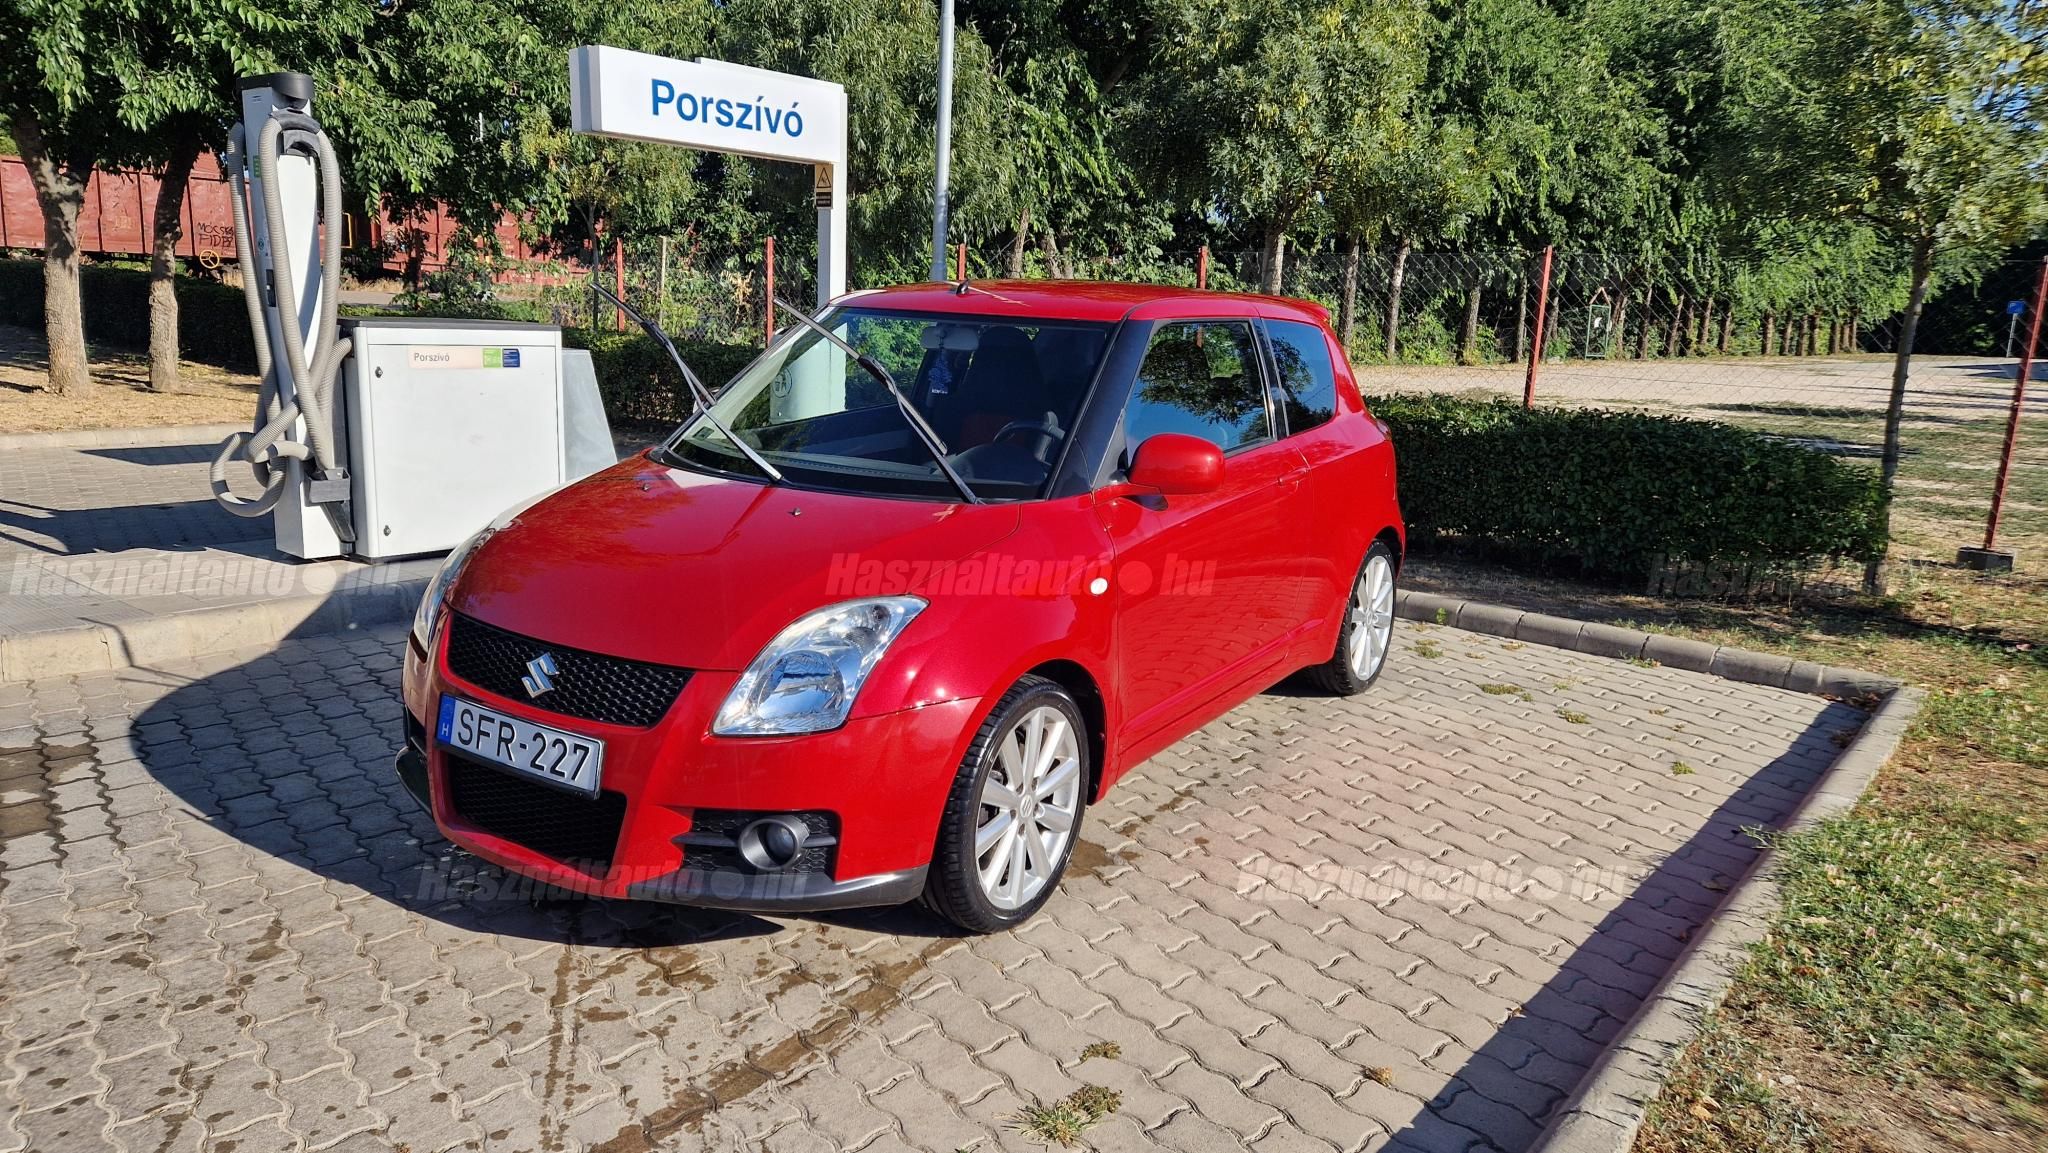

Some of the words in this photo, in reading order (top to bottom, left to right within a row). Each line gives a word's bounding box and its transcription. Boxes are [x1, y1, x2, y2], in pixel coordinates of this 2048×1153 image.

[651, 78, 803, 138] Porszívó
[414, 352, 450, 362] Porszívó
[440, 723, 450, 737] H
[457, 708, 590, 782] SFR-227
